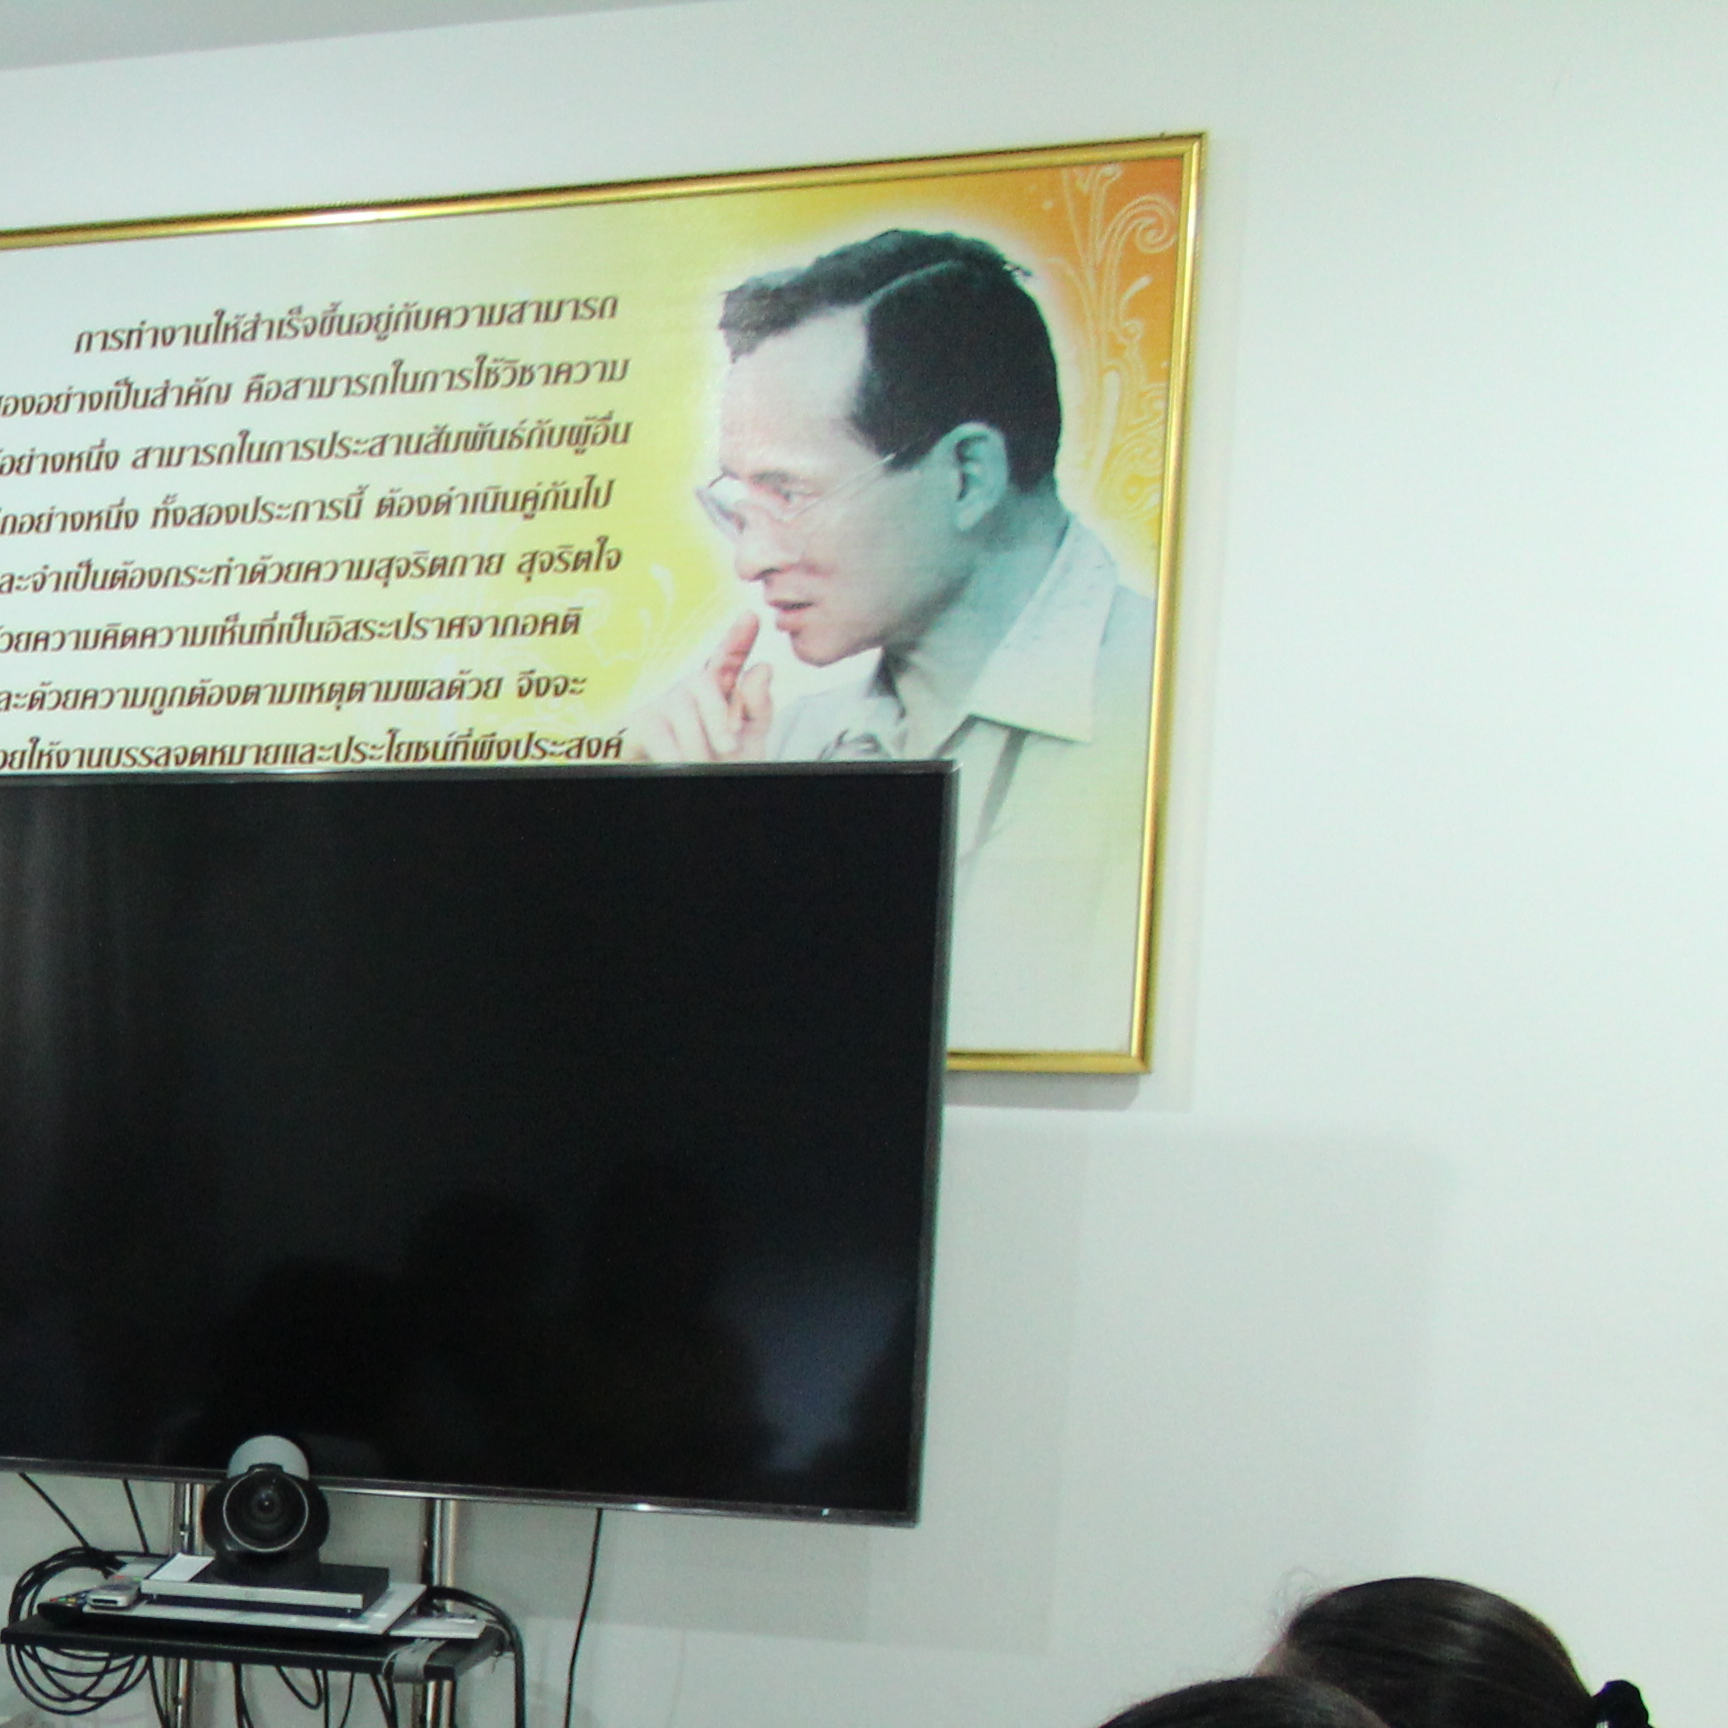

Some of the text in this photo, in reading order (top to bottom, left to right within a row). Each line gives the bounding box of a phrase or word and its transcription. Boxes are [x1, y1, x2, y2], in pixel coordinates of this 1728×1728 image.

[75, 294, 619, 355] การทำงานให้สำเร็จขึ้นอยู่กับความสามารถ
[243, 354, 630, 404] คือสามารถในการใช้วิชาความ
[131, 410, 634, 470] สามารถในการประสานสัมพันธ์กับผู้อื่น
[150, 484, 367, 530] ทั้งสองประการนี้
[375, 474, 616, 521] ต้องดำเนินคู่กันไป
[517, 535, 623, 583] สุจริตใจ
[516, 670, 588, 701] จึงจะ
